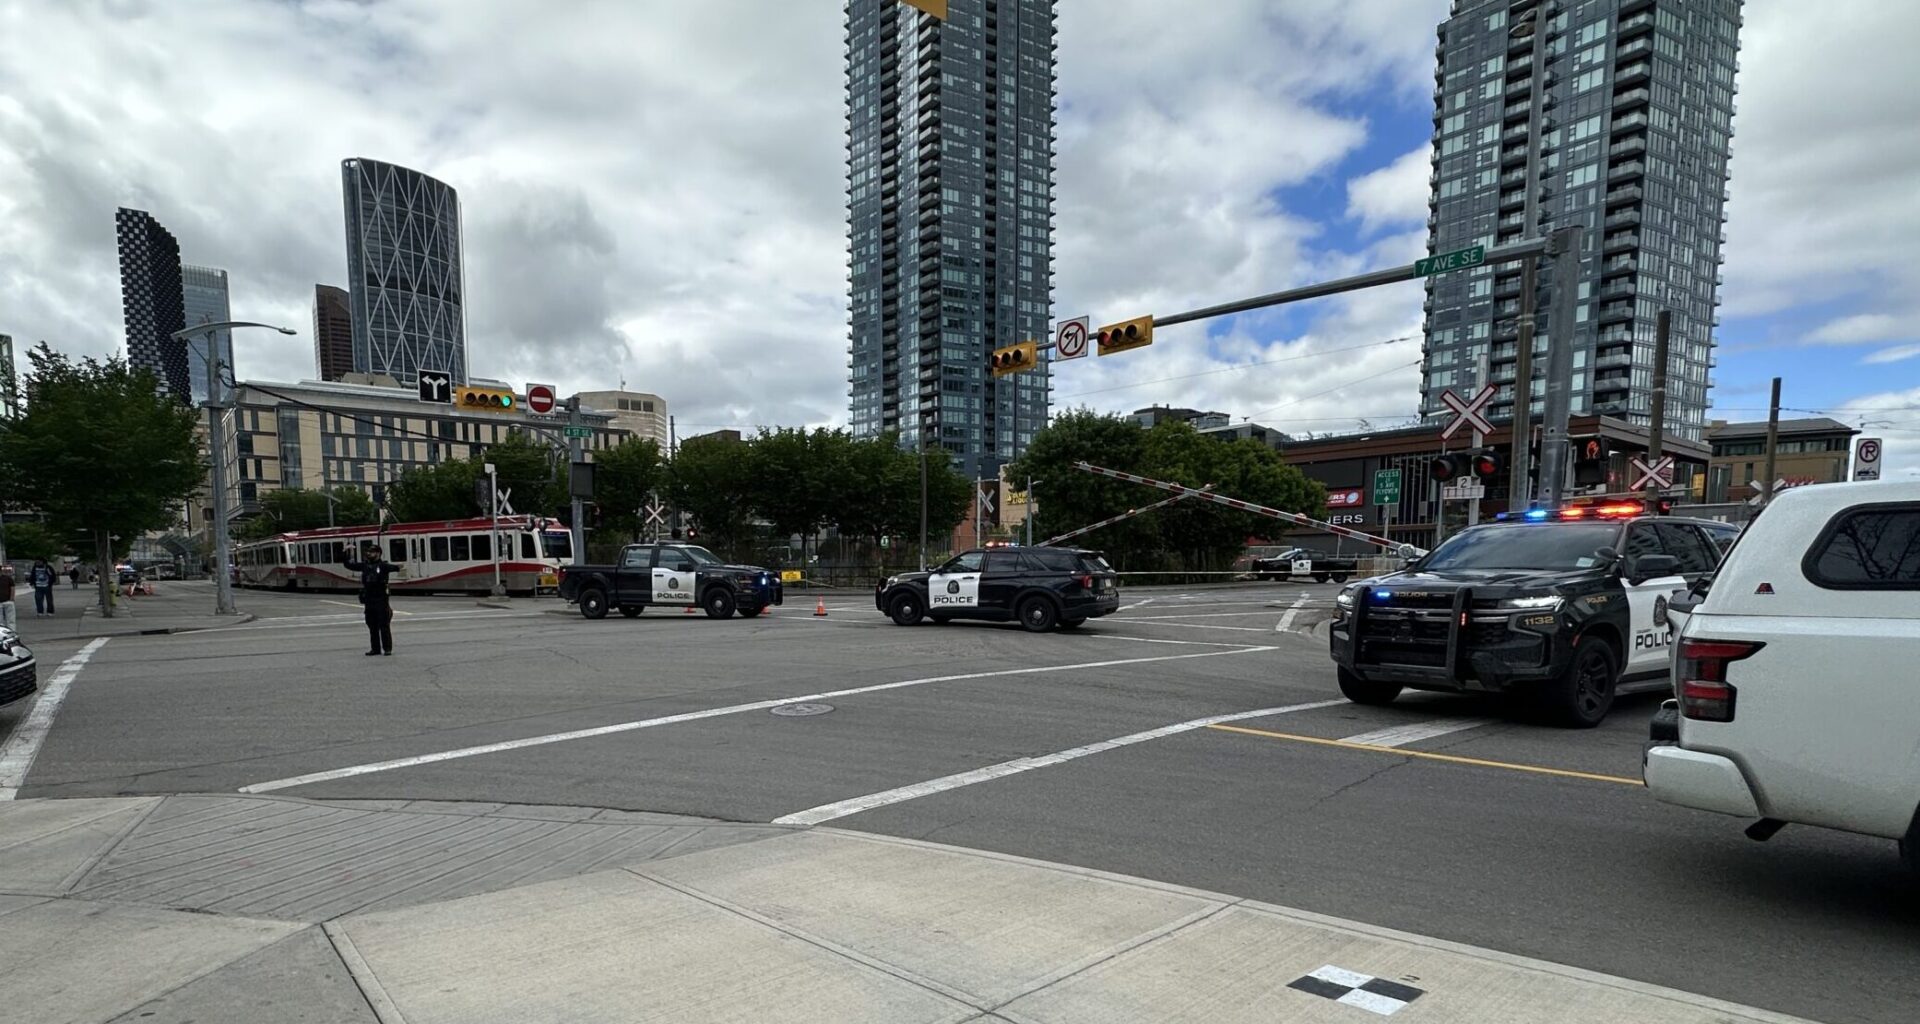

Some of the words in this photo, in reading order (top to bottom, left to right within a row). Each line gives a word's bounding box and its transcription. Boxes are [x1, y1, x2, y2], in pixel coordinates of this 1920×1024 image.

[1421, 262, 1428, 275] 7
[1433, 255, 1455, 271] AVE
[1462, 249, 1478, 265] SE
[1461, 477, 1467, 488] 2
[1585, 596, 1608, 604] POLICE
[1525, 616, 1555, 625] 1132
[1635, 631, 1673, 650] POLIC
